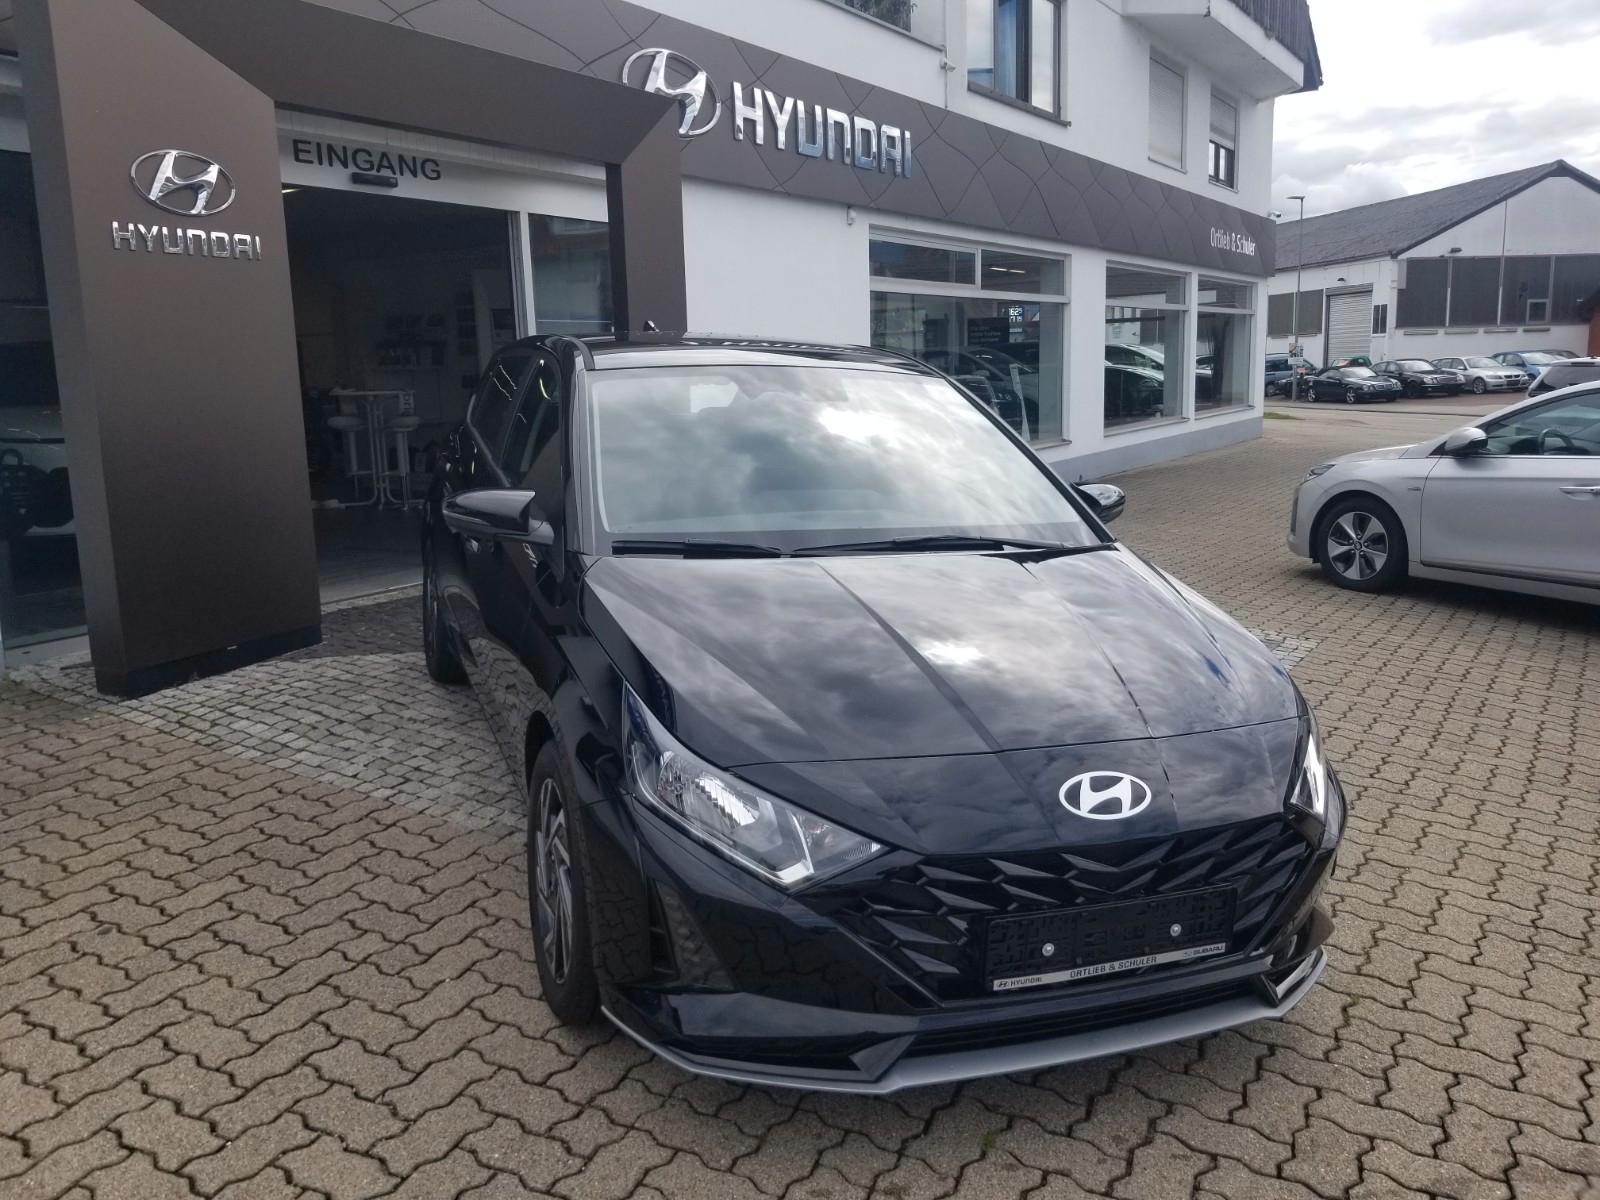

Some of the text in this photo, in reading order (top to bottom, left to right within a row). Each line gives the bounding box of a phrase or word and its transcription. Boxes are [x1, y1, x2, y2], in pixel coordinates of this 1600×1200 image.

[733, 80, 912, 179] HYUNDAI
[292, 138, 441, 181] EINGANG
[111, 220, 262, 261] HYUNDAI
[1010, 976, 1043, 987] HYUNDAI
[1069, 955, 1157, 979] ORTLIEB & SCHULER
